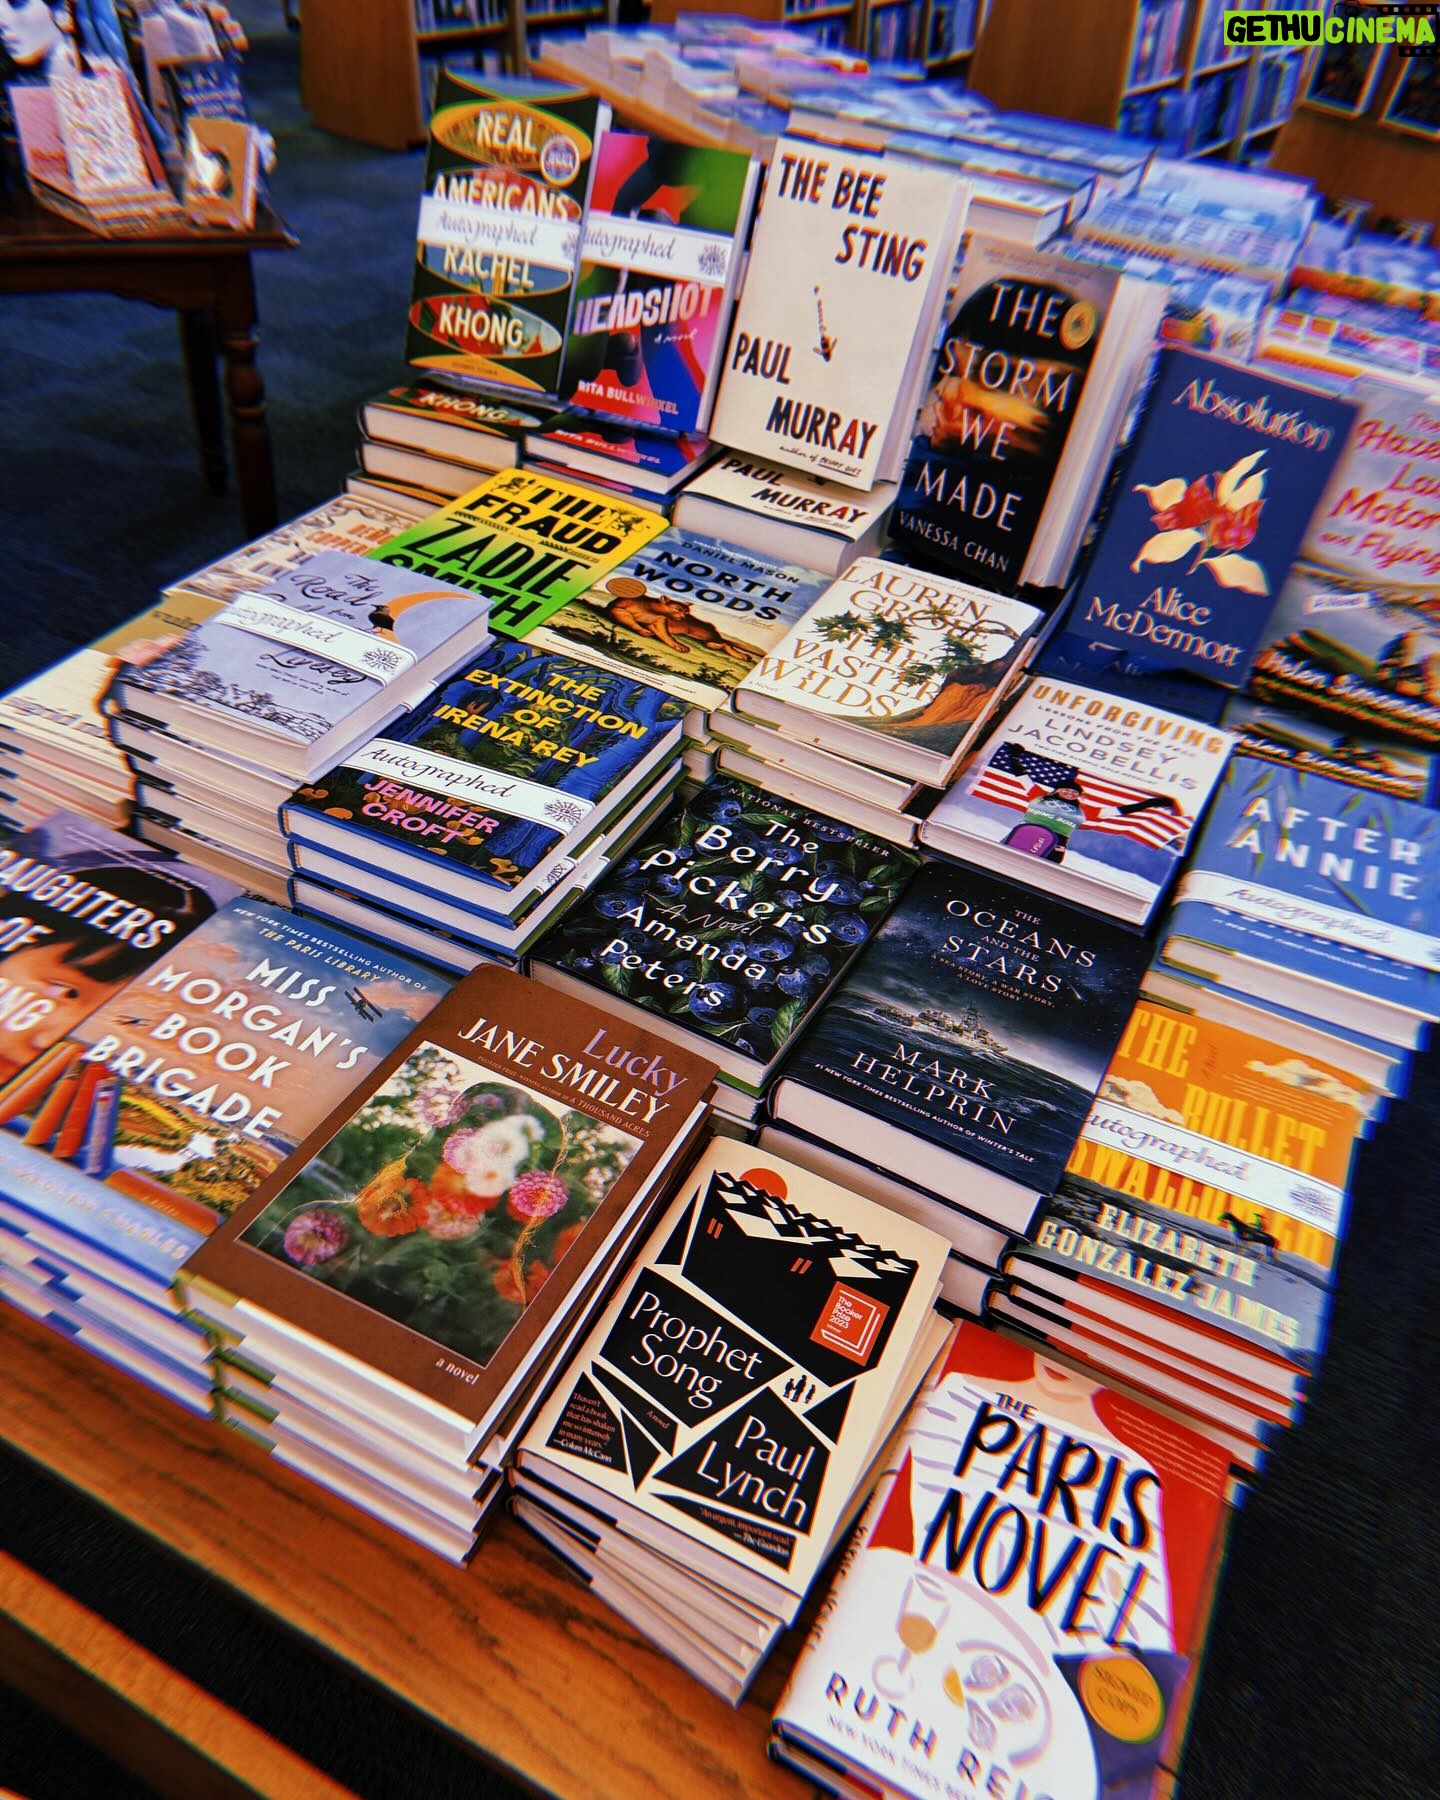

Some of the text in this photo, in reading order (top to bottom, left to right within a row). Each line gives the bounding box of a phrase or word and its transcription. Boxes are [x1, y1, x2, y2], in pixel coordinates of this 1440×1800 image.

[477, 111, 537, 151] REAL
[434, 173, 570, 222] AMERICANS
[778, 153, 888, 218] THE BEE
[437, 211, 538, 247] Autographed
[582, 227, 675, 260] utographed
[835, 224, 928, 282] STING
[443, 245, 534, 288] RACHEL
[439, 304, 523, 348] KHONG
[574, 282, 714, 335] HEADSHOT
[990, 283, 1065, 338] THE
[732, 332, 792, 384] PAUL
[938, 338, 1075, 412] STORM
[419, 392, 507, 421] KHONG
[578, 380, 604, 398] RITA
[1172, 379, 1336, 451] Absolution
[766, 397, 877, 459] MURRAY
[960, 408, 1017, 461] WE
[722, 458, 786, 487] PAUL
[915, 462, 1022, 532] MADE
[464, 494, 623, 554] FRAUD
[751, 489, 869, 523] MURRAY
[403, 518, 591, 599] ZADIE
[681, 543, 737, 564] DANIEL
[742, 561, 800, 583] MASON
[899, 511, 1011, 573] VANESSA CHAN
[290, 574, 383, 606] Road
[344, 574, 380, 592] The
[633, 563, 782, 620] WOODS
[655, 551, 793, 603] NORTH
[842, 565, 991, 620] LAUREN
[1140, 586, 1212, 626] Alice
[844, 628, 928, 671] THE
[1084, 596, 1242, 667] McDermott
[547, 673, 608, 701] THE
[759, 655, 901, 717] WILDS
[792, 638, 942, 703] VASTER
[464, 669, 649, 740] EXTINCTION
[514, 708, 563, 730] OF
[1032, 685, 1225, 754] UNFORGIVING
[433, 704, 600, 769] IRENA REY
[1008, 725, 1198, 790] JACOBELLIS
[1045, 718, 1178, 765] LINDSEY
[361, 747, 513, 799] Autographed
[361, 802, 467, 845] CROFT
[364, 778, 502, 834] JENNIFER
[728, 787, 891, 858] NATIONAL BESTSELLER
[1243, 796, 1422, 864] AFTER
[695, 825, 840, 903] Berry
[764, 819, 821, 854] The
[1226, 828, 1420, 899] ANNIE
[617, 905, 769, 981] Amanda
[687, 913, 764, 937] Novel
[946, 900, 1097, 969] OCEANS
[1015, 908, 1042, 925] THE
[233, 908, 427, 991] NEW YORK TIMES BESTSELLING AUTHOR OF
[258, 927, 381, 982] THE PARIS LIBRARY
[600, 938, 727, 1007] Peters
[943, 935, 1063, 993] STARS
[981, 934, 1041, 963] AND THE
[246, 957, 337, 1007] MISS
[149, 964, 369, 1071] MORGAN'S
[1118, 1008, 1199, 1082] THE
[150, 1012, 292, 1088] BOOK
[458, 1017, 671, 1124] JANE SMILEY
[582, 1027, 689, 1097] Lucky
[892, 1043, 999, 1100] MARK
[82, 1033, 283, 1139] BRIGADE
[825, 1066, 842, 1078] NEW
[842, 1074, 863, 1088] YORK
[863, 1083, 884, 1097] TIMES
[884, 1093, 931, 1117] BESTSELLING
[932, 1115, 964, 1132] AUTHOR
[965, 1128, 975, 1137] OF
[977, 1135, 1013, 1155] WINTER'S
[1015, 1151, 1035, 1163] TALE
[850, 1052, 1017, 1135] HELPRIN
[578, 1101, 622, 1124] THOUSAND
[623, 1121, 651, 1138] ACRES
[1084, 1109, 1251, 1181] utographed
[1098, 1203, 1259, 1287] ELIZABETH
[836, 1302, 863, 1320] Booker
[839, 1296, 852, 1307] The
[1036, 1220, 1299, 1347] GONZALEZ JAMES
[629, 1292, 764, 1380] Prophet
[830, 1315, 849, 1329] 2023
[833, 1309, 851, 1322] Prize
[436, 1358, 480, 1385] a novel
[631, 1333, 724, 1409] Song
[996, 1392, 1039, 1420] THE
[734, 1415, 816, 1481] Paul
[953, 1402, 1162, 1551] PARIS
[698, 1440, 808, 1526] Lynch
[920, 1487, 1149, 1648] NOVEL
[825, 1671, 1052, 1800] RUTH REI
